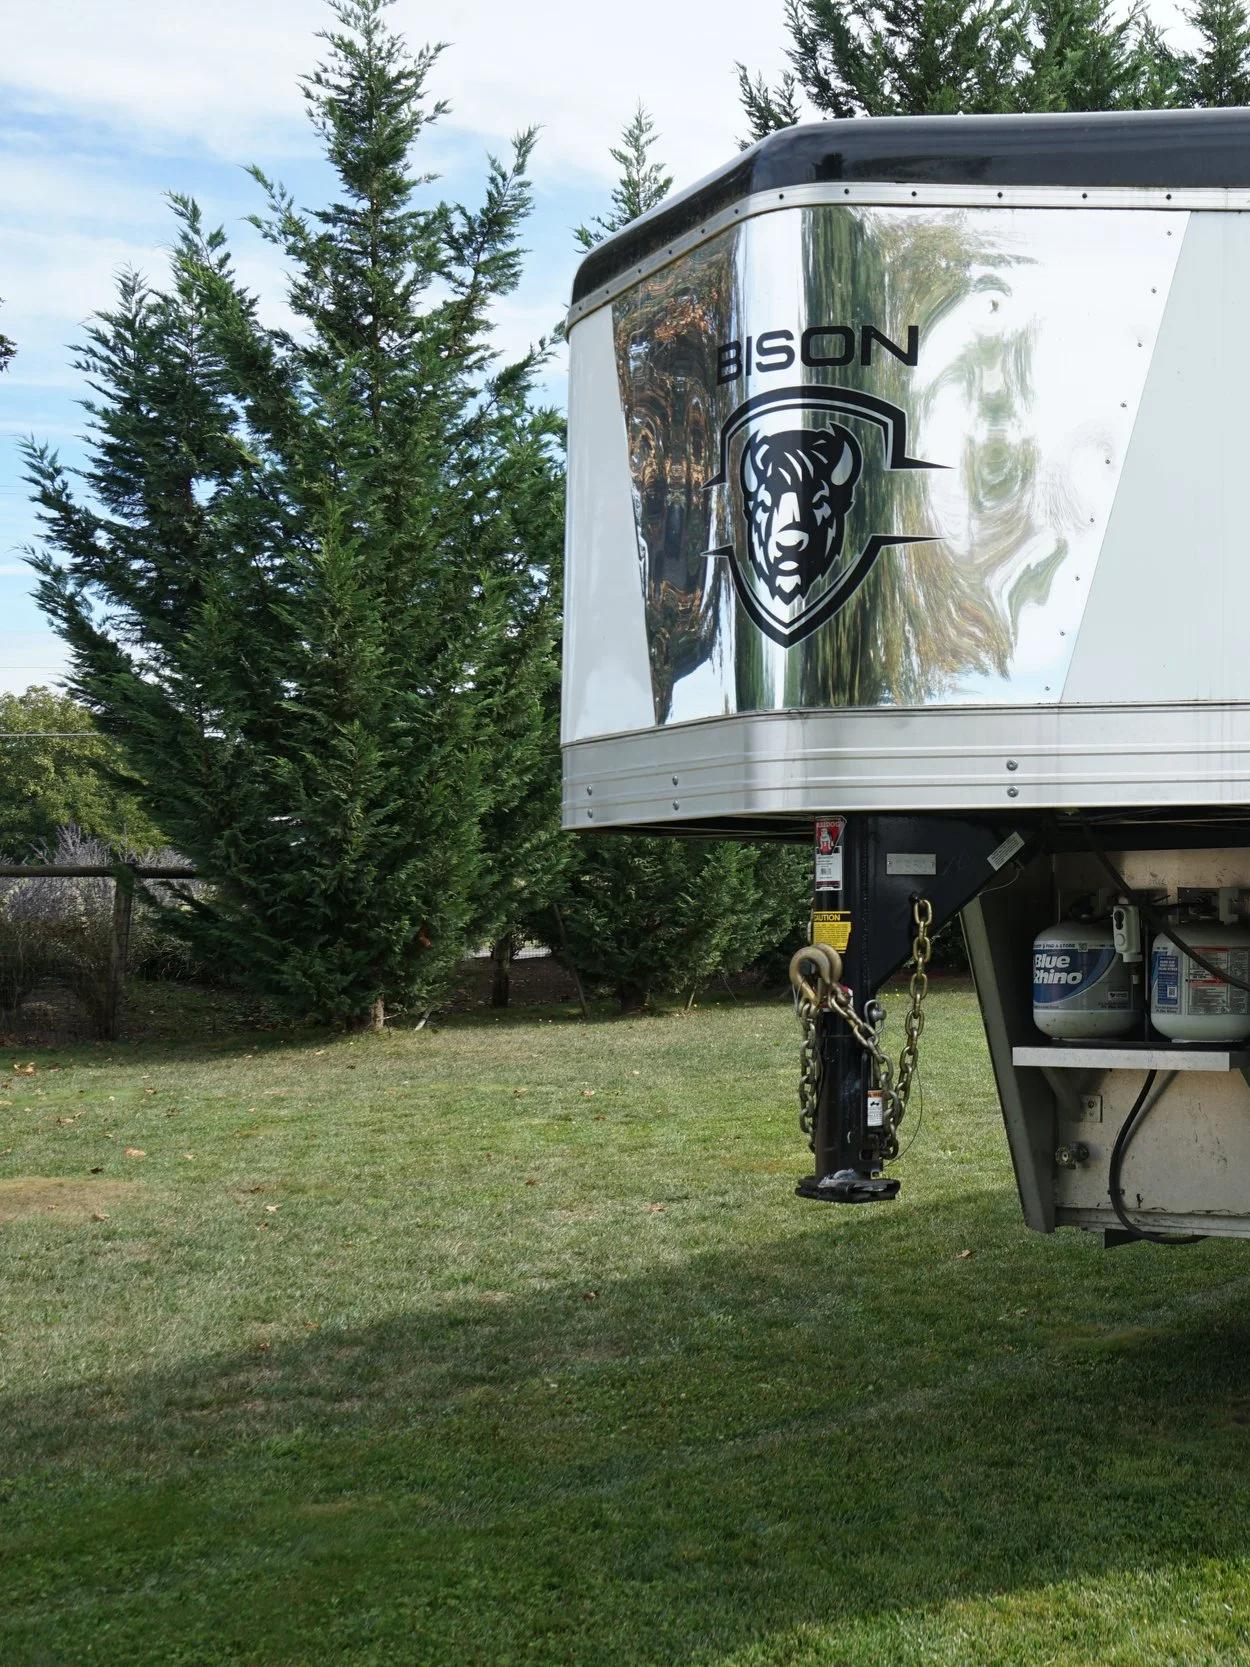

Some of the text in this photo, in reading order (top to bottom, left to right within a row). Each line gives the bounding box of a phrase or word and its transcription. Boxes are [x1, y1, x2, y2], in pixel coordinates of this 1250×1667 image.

[717, 325, 919, 386] BISON
[1034, 954, 1071, 968] Blue
[1033, 969, 1083, 985] Rhino
